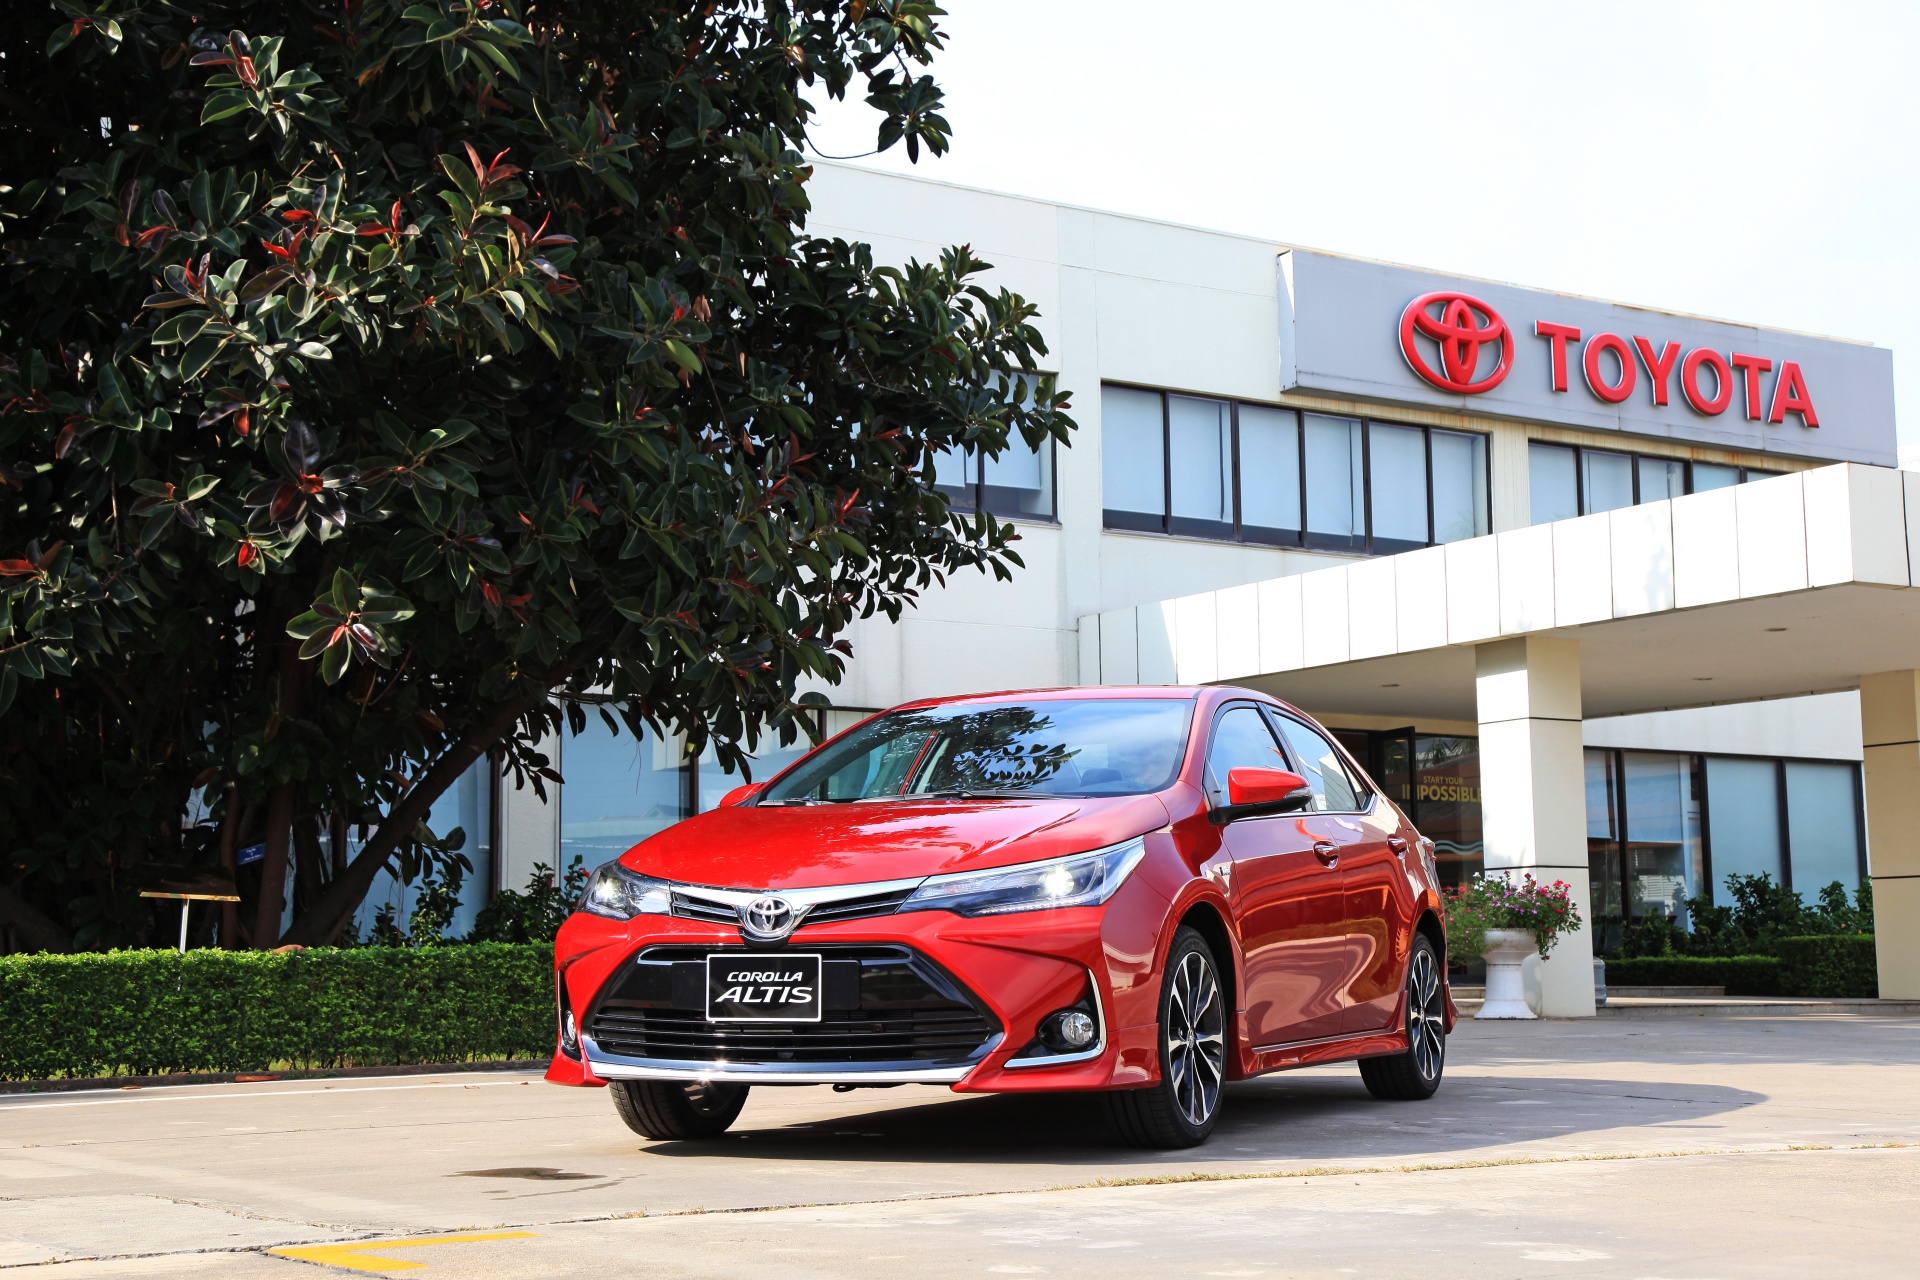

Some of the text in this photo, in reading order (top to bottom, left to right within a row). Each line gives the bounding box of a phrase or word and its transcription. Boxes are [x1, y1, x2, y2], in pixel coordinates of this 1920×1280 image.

[1534, 320, 1820, 428] TOYOTA
[1424, 776, 1464, 785] START YOUR
[727, 972, 803, 983] COROLLA
[715, 987, 813, 1003] ALTIS
